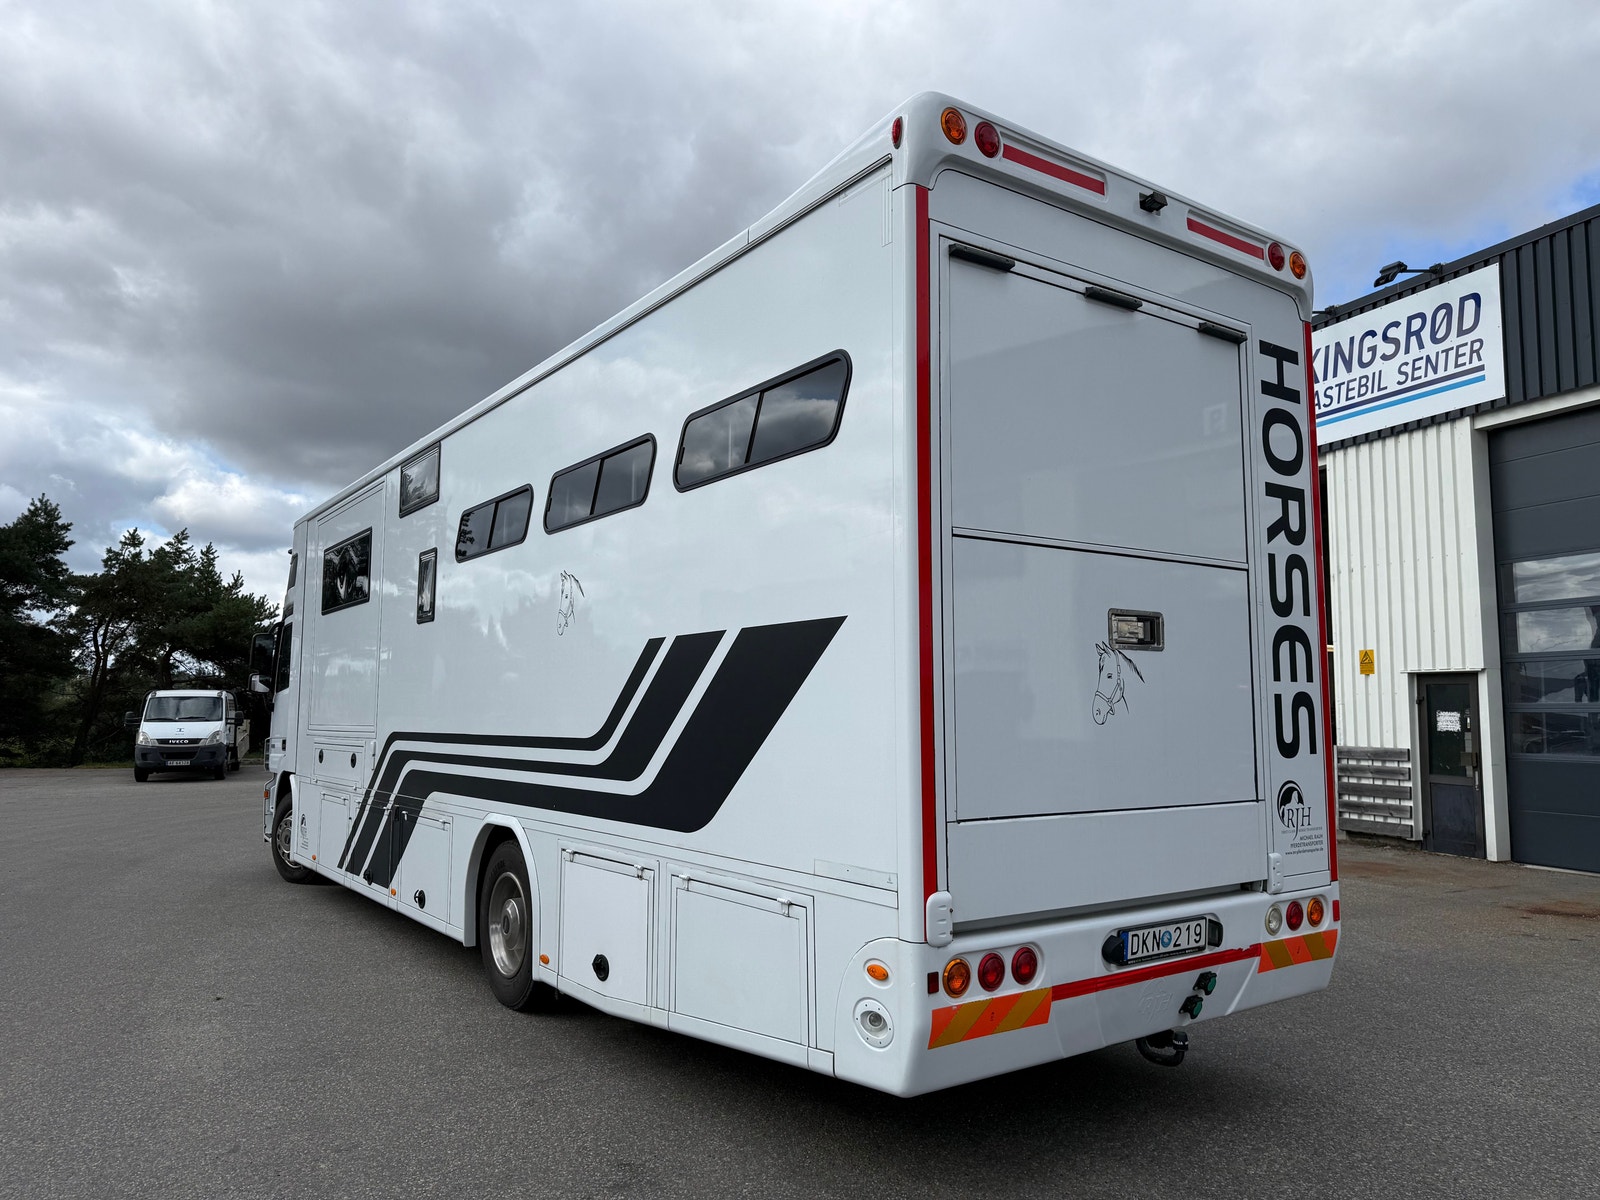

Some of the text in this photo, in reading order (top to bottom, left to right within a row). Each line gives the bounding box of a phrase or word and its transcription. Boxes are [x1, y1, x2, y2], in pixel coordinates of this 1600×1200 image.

[1312, 292, 1482, 385] KINGSRØD
[1396, 338, 1485, 386] SENTER
[1258, 339, 1318, 760] HORSES
[1130, 929, 1161, 956] DKN
[1173, 923, 1202, 948] 219
